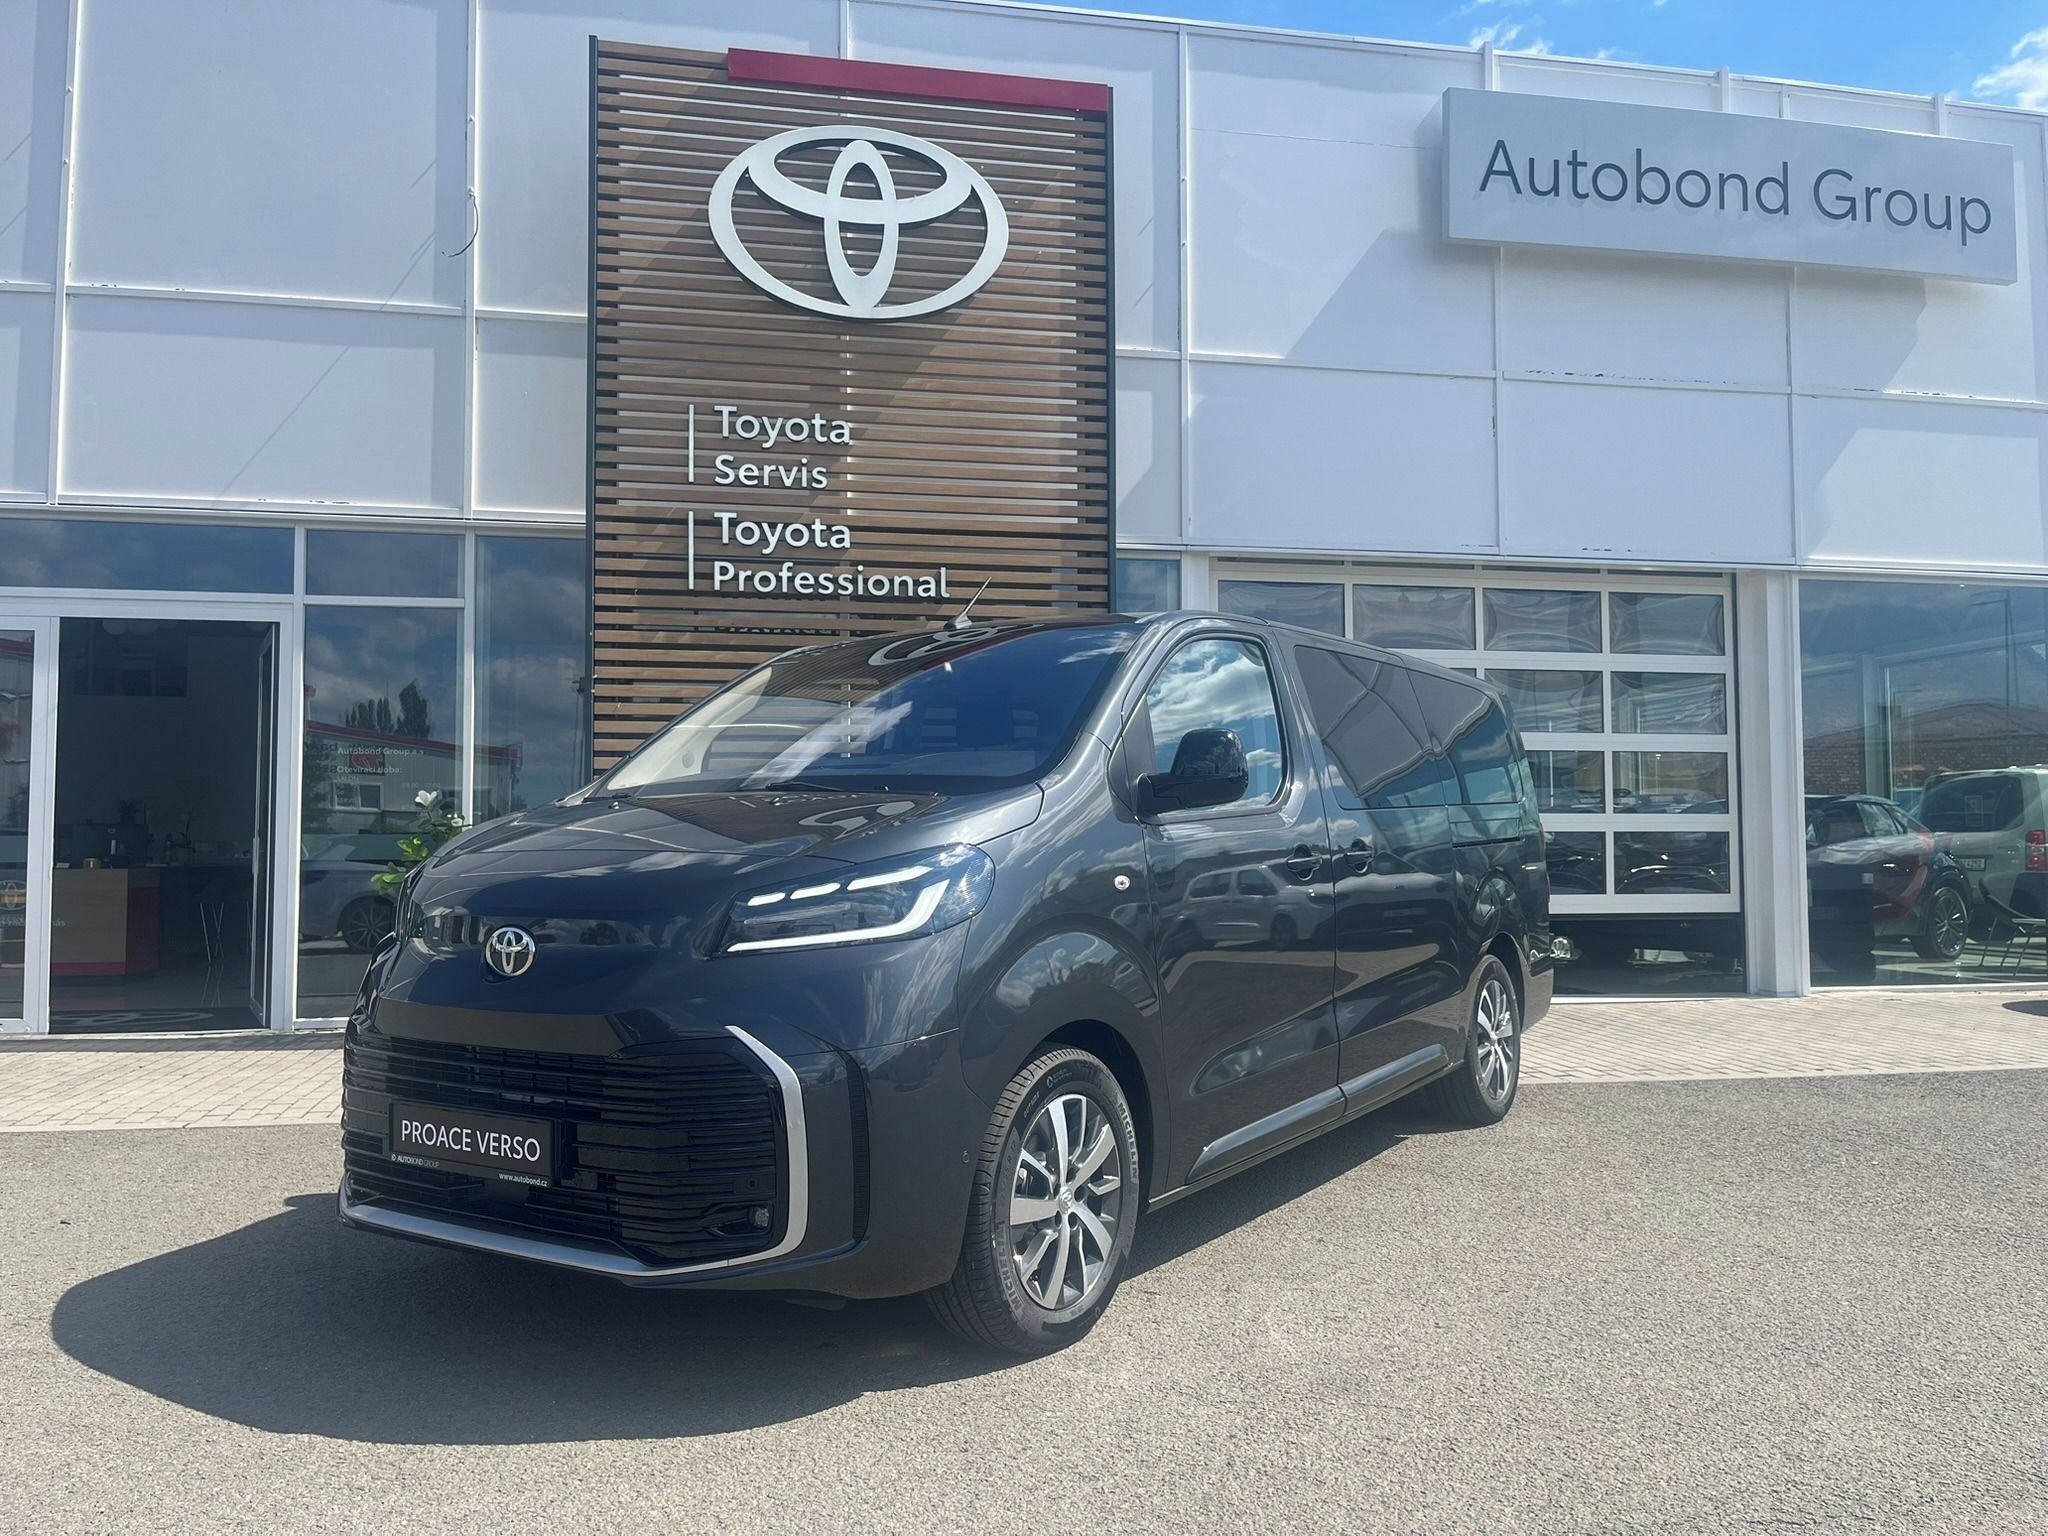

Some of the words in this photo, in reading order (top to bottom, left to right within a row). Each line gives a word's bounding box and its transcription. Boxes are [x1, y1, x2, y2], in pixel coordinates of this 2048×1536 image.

[1479, 139, 1790, 216] Autobond
[1812, 168, 1993, 247] Group
[713, 405, 852, 449] Toyota
[714, 454, 828, 489] Servis
[713, 512, 852, 555] Toyota
[713, 561, 950, 599] Professional
[337, 746, 381, 756] Autobond
[401, 1119, 472, 1152] PROACE
[476, 1130, 541, 1163] VERSO
[1117, 1102, 1138, 1179] MICHELIN
[498, 1172, 548, 1187] www.autobond.cz
